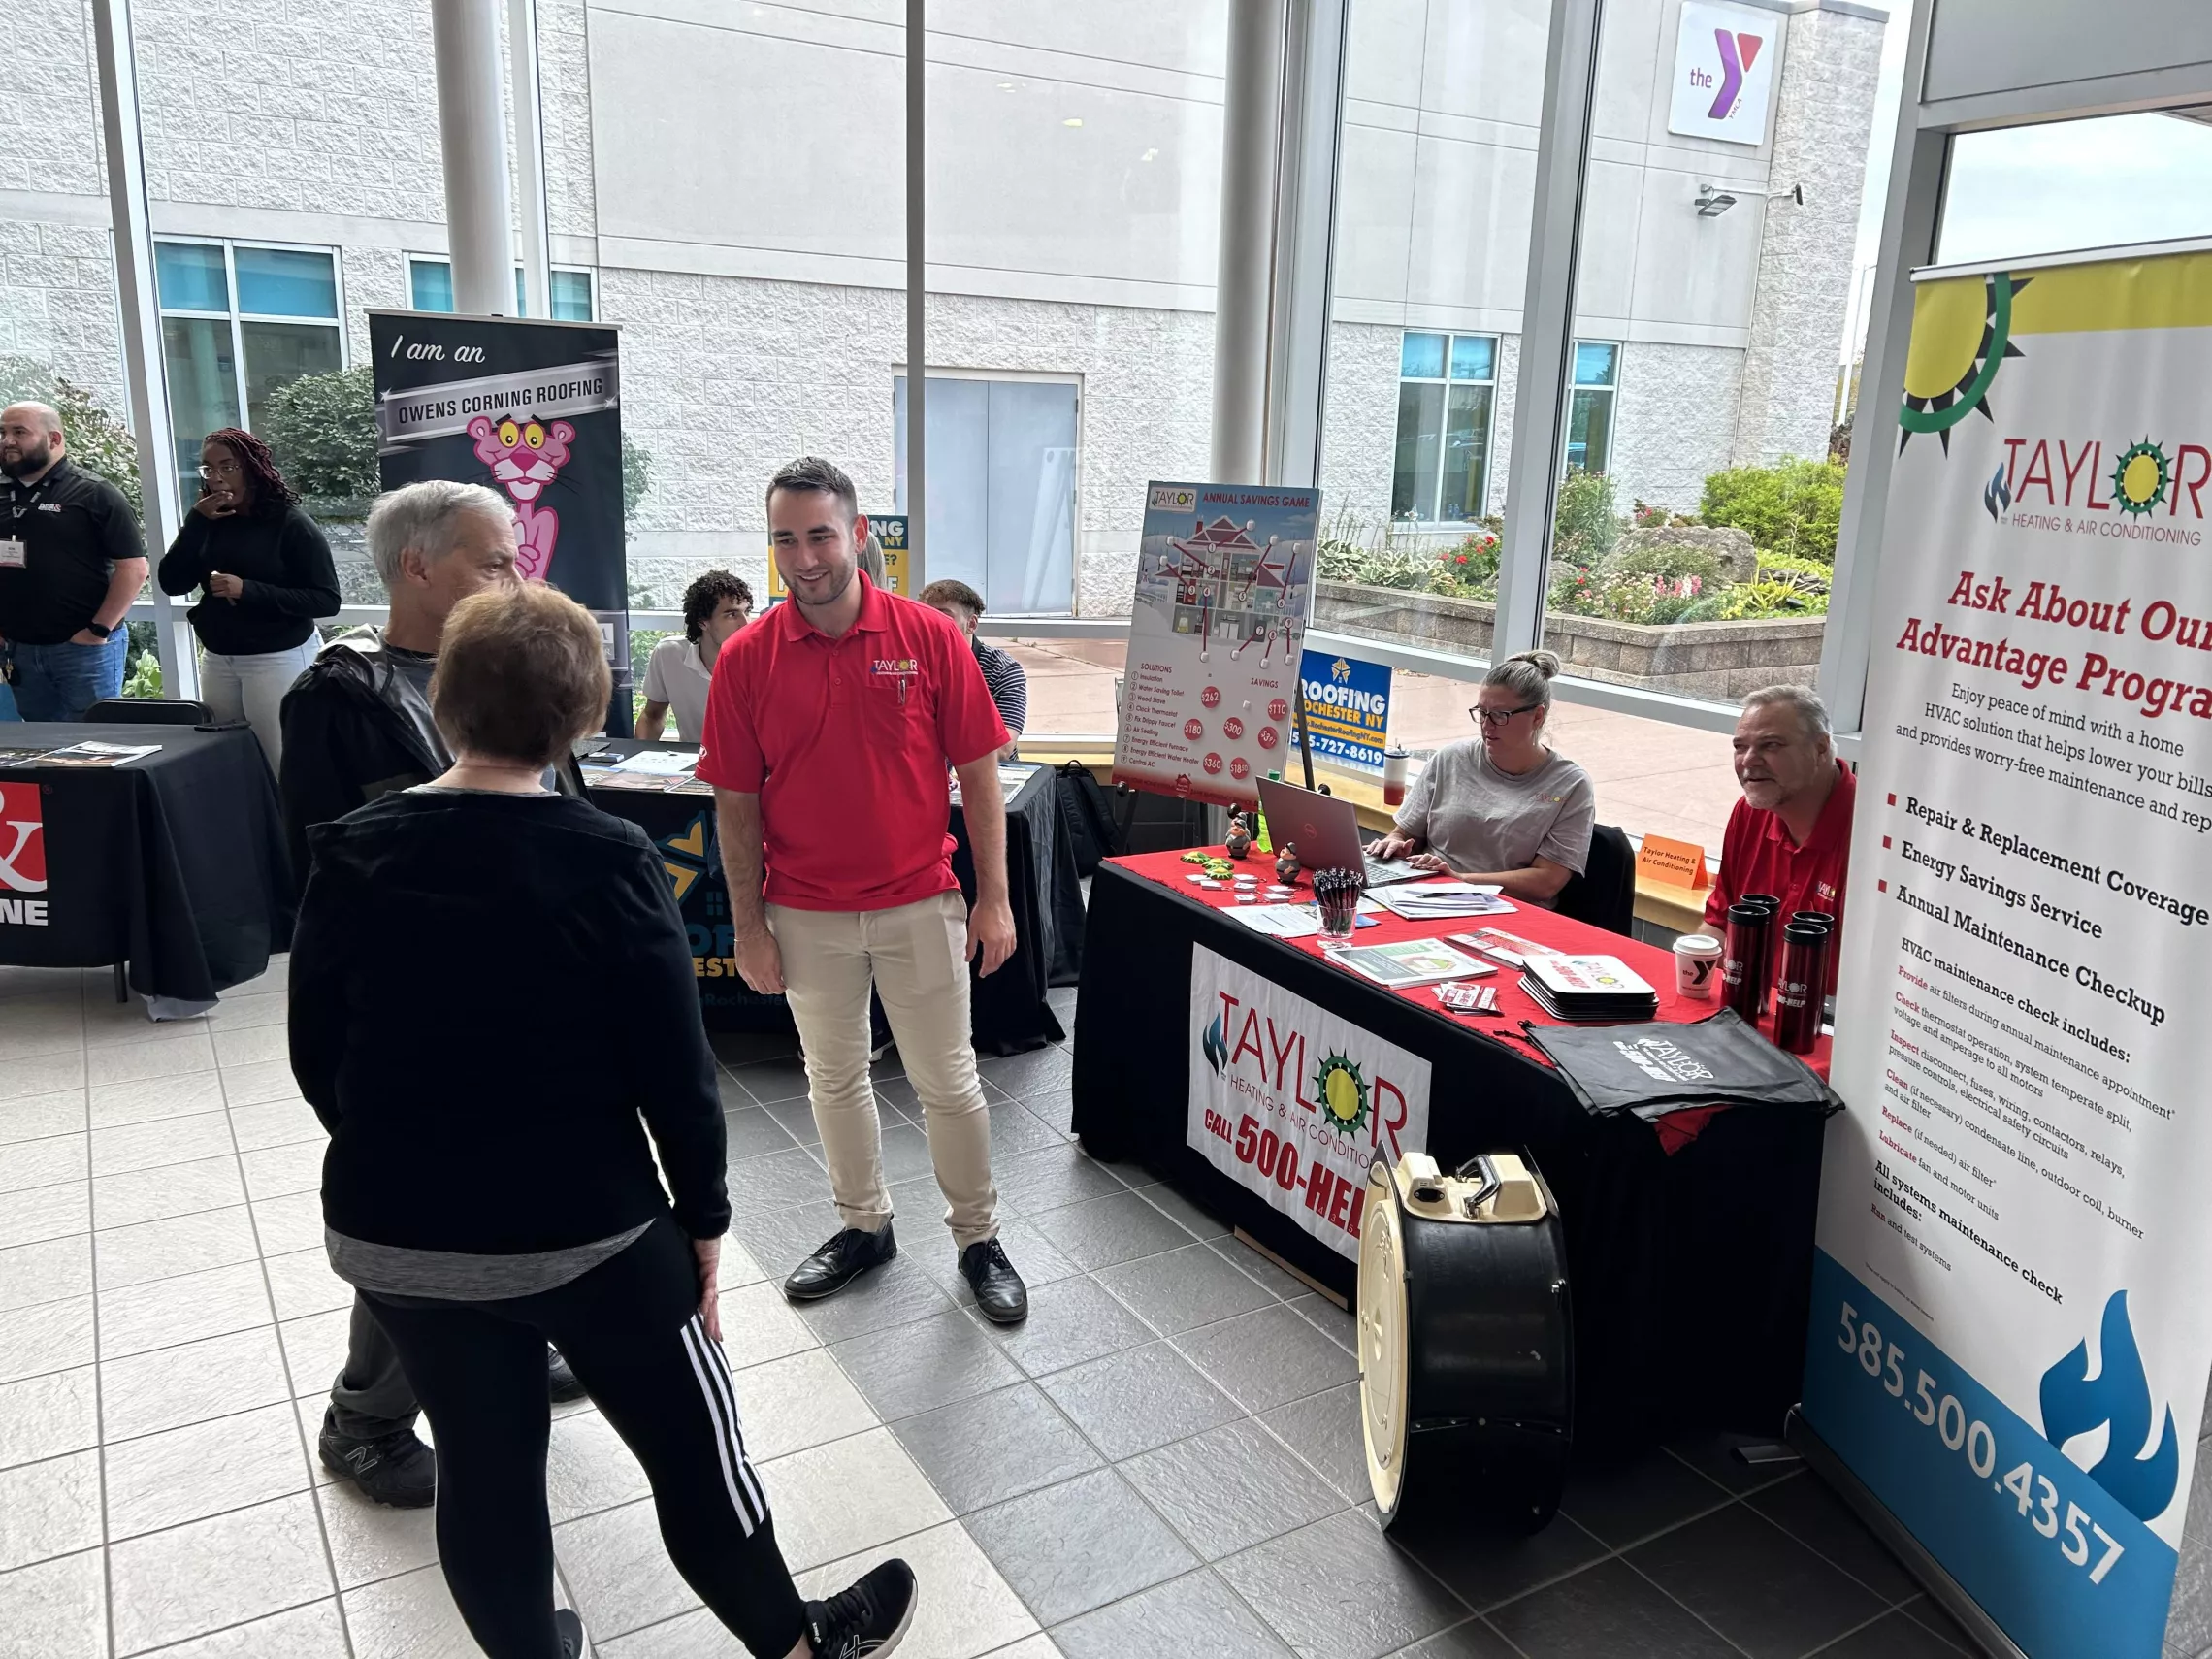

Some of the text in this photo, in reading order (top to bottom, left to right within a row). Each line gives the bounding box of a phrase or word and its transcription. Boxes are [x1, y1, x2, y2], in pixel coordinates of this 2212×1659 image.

[1690, 28, 1763, 120] the Y
[1728, 98, 1742, 119] YMCA
[390, 335, 486, 363] I am an
[398, 378, 602, 425] OWENS CORNING ROOFING
[1155, 490, 1194, 505] TAYLOR
[1203, 492, 1310, 507] ANNUAL SAVINGS GAME
[2003, 434, 2212, 522] TAYLOR
[884, 537, 903, 546] NY
[2012, 513, 2061, 533] HEATING
[2065, 518, 2073, 533] &
[2076, 519, 2098, 537] AIR
[2100, 522, 2202, 547] CONDITIONING
[1947, 570, 2012, 614] Ask
[2015, 581, 2131, 635] About
[873, 659, 918, 671] TAYLOR
[1140, 663, 1172, 673] SOLUTIONS
[1251, 678, 1279, 688] SAVINGS
[1896, 617, 2068, 690] Advantage
[1185, 724, 1202, 734] $180
[1224, 721, 1242, 735] $300
[1201, 692, 1219, 702] $262
[1268, 704, 1286, 715] $110
[1301, 678, 1385, 715] ROOFING
[1303, 699, 1384, 729] OCHESTER NY
[1952, 683, 2184, 757] Enjoy peace of mind with a home
[1204, 758, 1221, 769] $360
[1291, 731, 1382, 764] 55-727-8619
[1896, 724, 1917, 740] and
[1919, 730, 1971, 757] provides
[1974, 747, 2045, 778] worry-free
[2048, 768, 2145, 809] maintenance
[2149, 798, 2178, 821] and
[1925, 702, 2212, 797] HVAC solution that helps lower your bills
[1642, 856, 1694, 876] Air Conditioning
[1643, 846, 1690, 865] Taylor Heating
[1901, 840, 2103, 939] Energy Savings Service
[1905, 796, 2210, 927] Repair & Replacement Coverage
[1896, 884, 2166, 1027] Annual Maintenance Checkup
[1898, 965, 1929, 990] Provide
[1930, 984, 1941, 997] air
[1942, 990, 1968, 1011] filters
[1968, 1004, 2000, 1029] during
[2001, 1021, 2033, 1045] annual
[2033, 1039, 2100, 1081] maintenance
[1901, 936, 2131, 1063] HVAC maintenance check includes:
[1219, 990, 1407, 1162] TAYLOR
[1894, 1005, 2044, 1097] voltage and amperage to all motors
[1895, 992, 2132, 1133] Check thermostat operation, system temperate split,
[1230, 1073, 1274, 1112] HEATING
[1279, 1103, 1286, 1117] &
[1290, 1113, 1306, 1133] AIR
[1309, 1124, 1370, 1169] CONDITIO
[1884, 1083, 1932, 1119] and air filter
[1889, 1045, 2068, 1159] pressure controls, electrical safety circuits
[1890, 1028, 2126, 1179] Inspect disconnect, fuses, wiring, contactors, relays,
[1881, 1105, 1970, 1172] Replace needed) air
[1886, 1068, 2145, 1240] Clean necessary) condensate line, outdoor coil, burner
[1205, 1109, 1366, 1240] CALL 500-HEL
[1873, 1177, 1923, 1222] includes:
[1879, 1129, 2000, 1220] Lubricate fan and motor units
[1870, 1202, 1952, 1272] Run and test systems
[1875, 1159, 2064, 1305] All systems maintenance check
[1838, 1301, 2125, 1585] 585.500.4357
